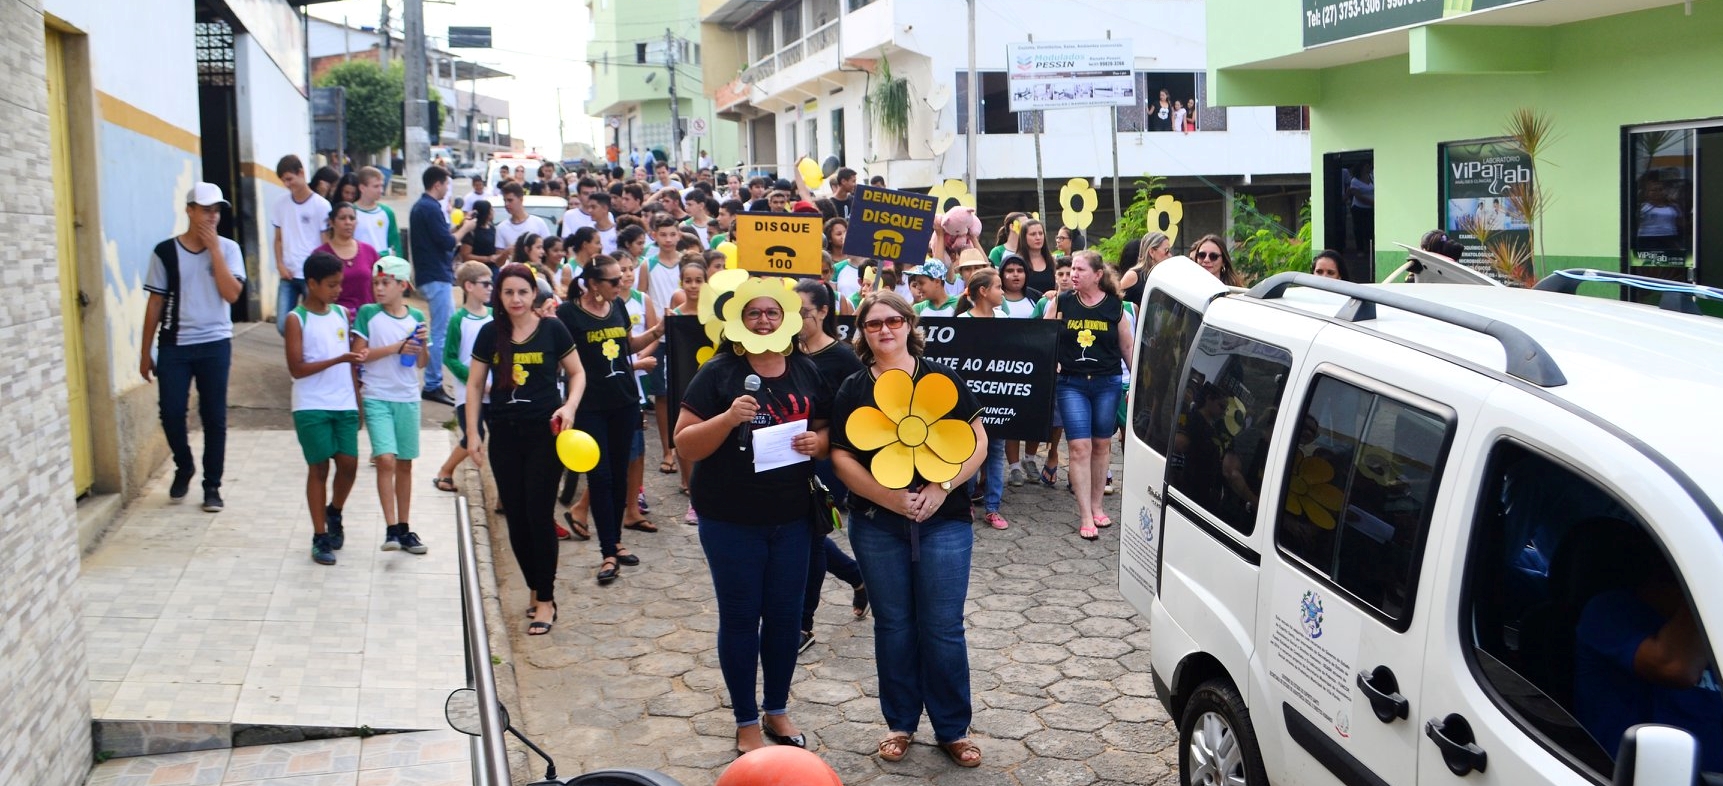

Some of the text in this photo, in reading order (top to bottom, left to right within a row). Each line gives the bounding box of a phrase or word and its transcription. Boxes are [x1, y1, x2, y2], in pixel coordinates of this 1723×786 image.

[1307, 9, 1320, 28] Tel:
[1322, 4, 1337, 28] (27)
[1035, 53, 1085, 61] Modulados
[863, 190, 932, 211] DENUNCIE
[755, 221, 810, 233] DISQUE
[862, 209, 924, 231] DISQUE
[873, 241, 902, 259] 100
[768, 258, 792, 269] 100
[962, 358, 982, 371] AO
[986, 360, 1034, 375] ABUSO
